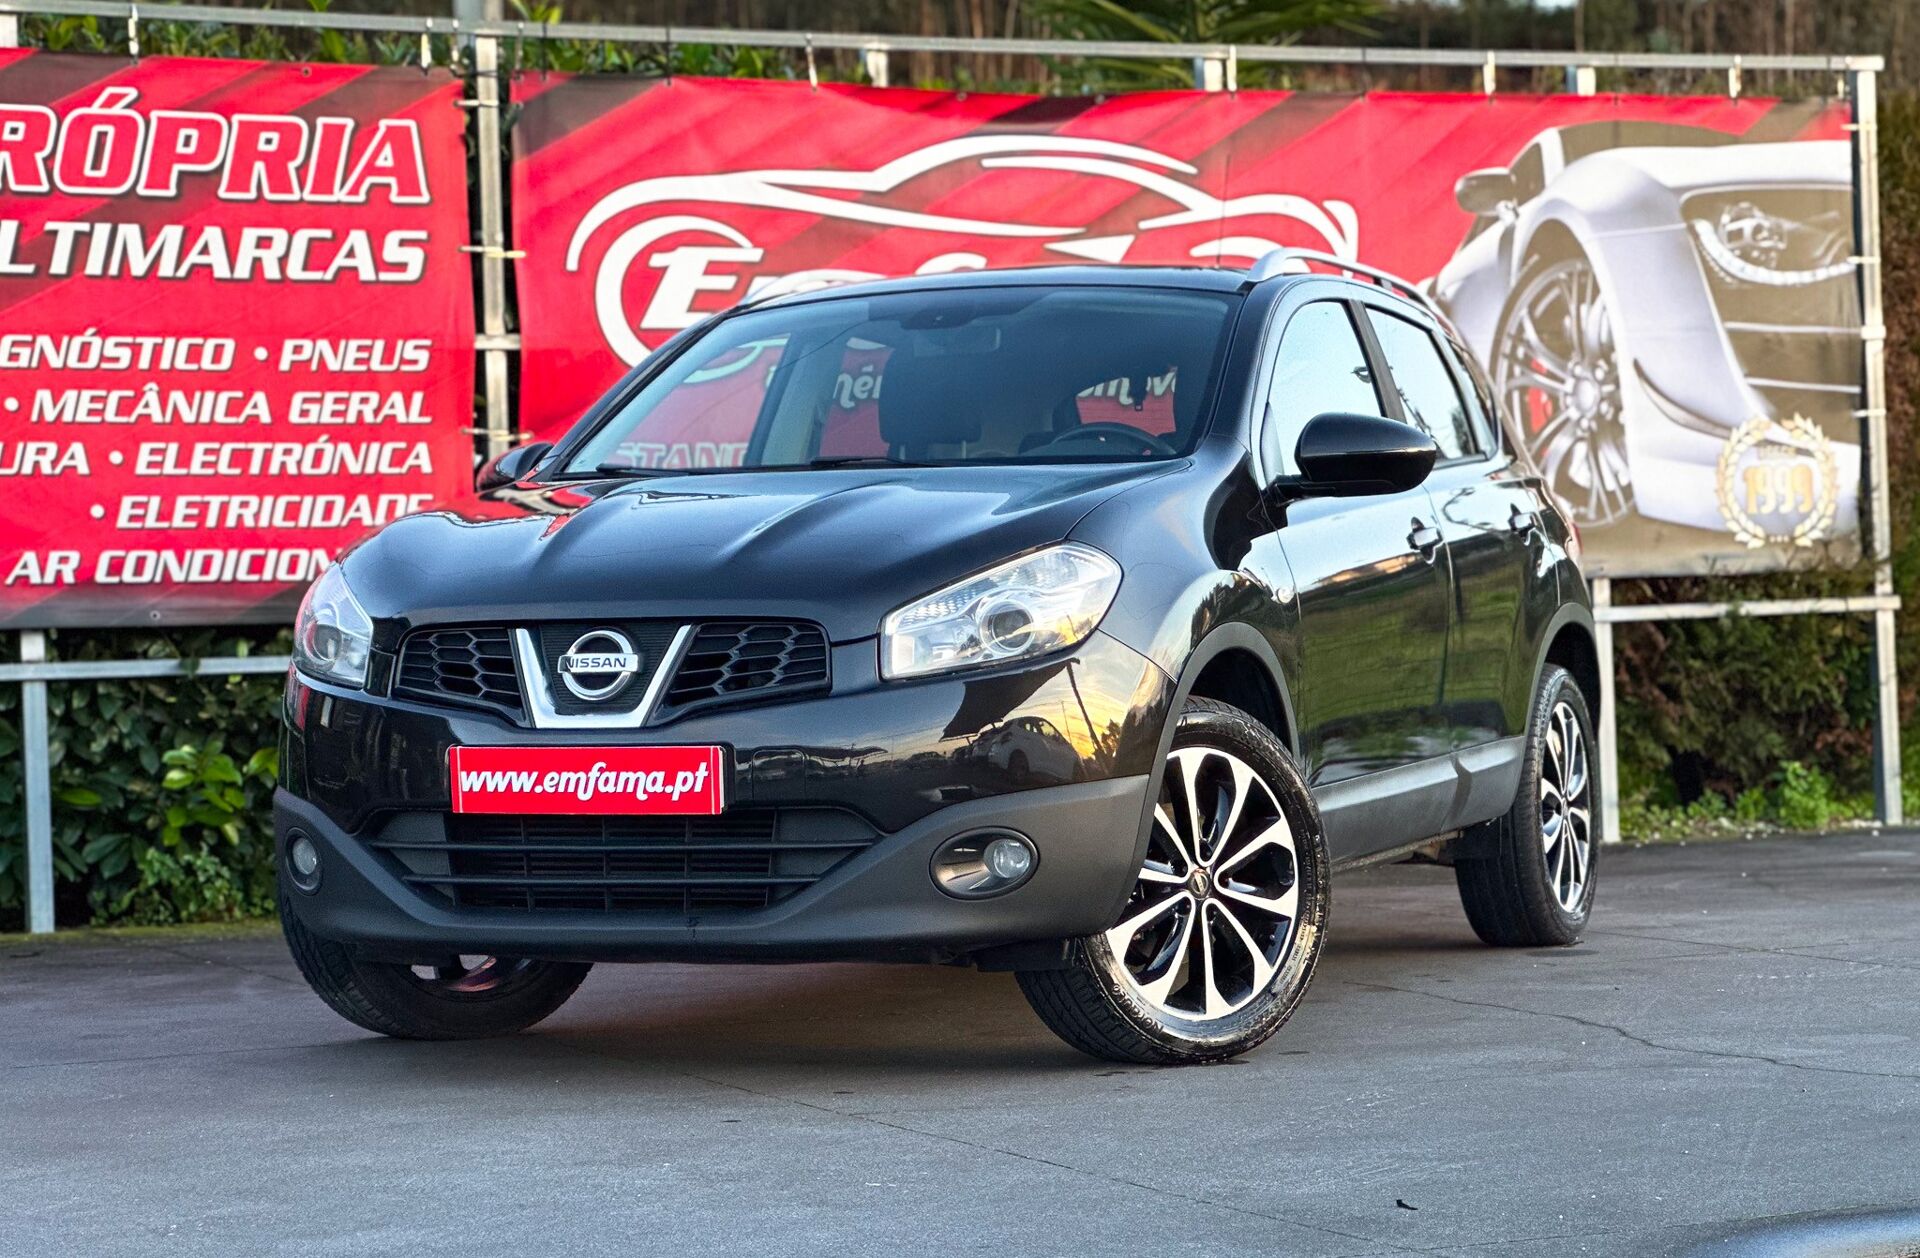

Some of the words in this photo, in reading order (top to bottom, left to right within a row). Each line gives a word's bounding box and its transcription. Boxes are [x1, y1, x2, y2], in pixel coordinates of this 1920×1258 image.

[0, 86, 431, 203] RÓPRIA
[0, 219, 429, 282] LTIMARCAS
[0, 328, 235, 371] GNÓSTICO
[279, 339, 432, 372] PNEUS
[30, 382, 272, 424] MECÂNICA
[288, 391, 432, 424] GERAL
[134, 435, 433, 475] ELECTRÓNICA
[1743, 464, 1813, 514] 1999
[6, 550, 80, 585] AR
[565, 657, 627, 668] NISSAN
[460, 762, 709, 800] www.emfama.pt
